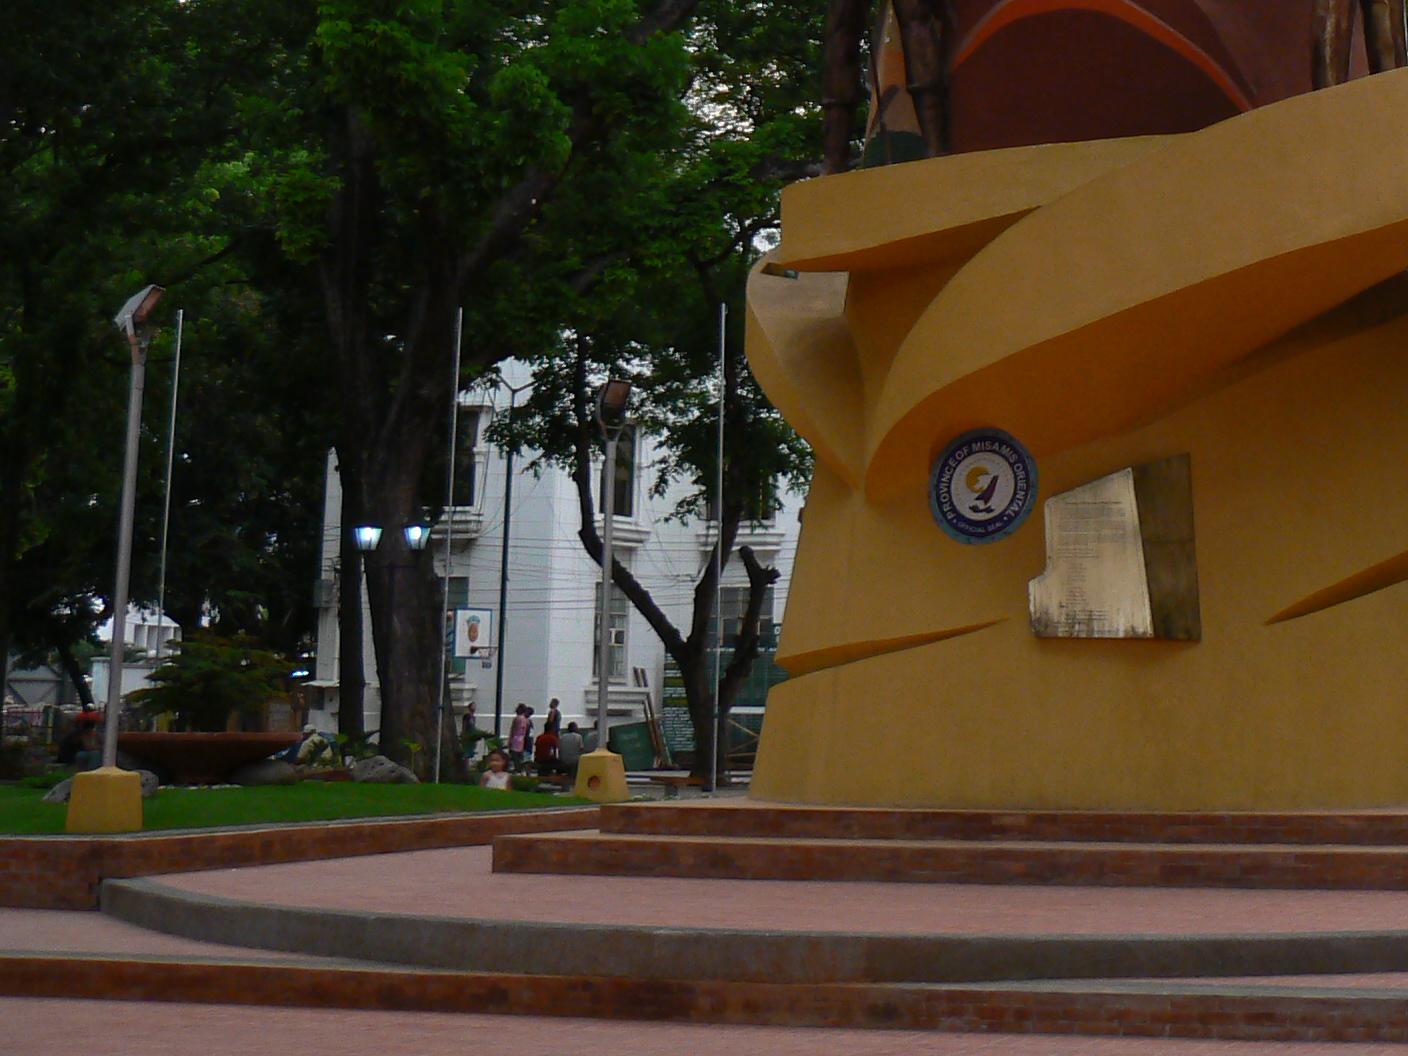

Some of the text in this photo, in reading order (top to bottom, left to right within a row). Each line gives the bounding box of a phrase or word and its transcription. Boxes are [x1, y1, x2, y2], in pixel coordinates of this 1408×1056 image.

[939, 440, 1027, 520] PROVINCE OF MISAMIS ORIENTAL
